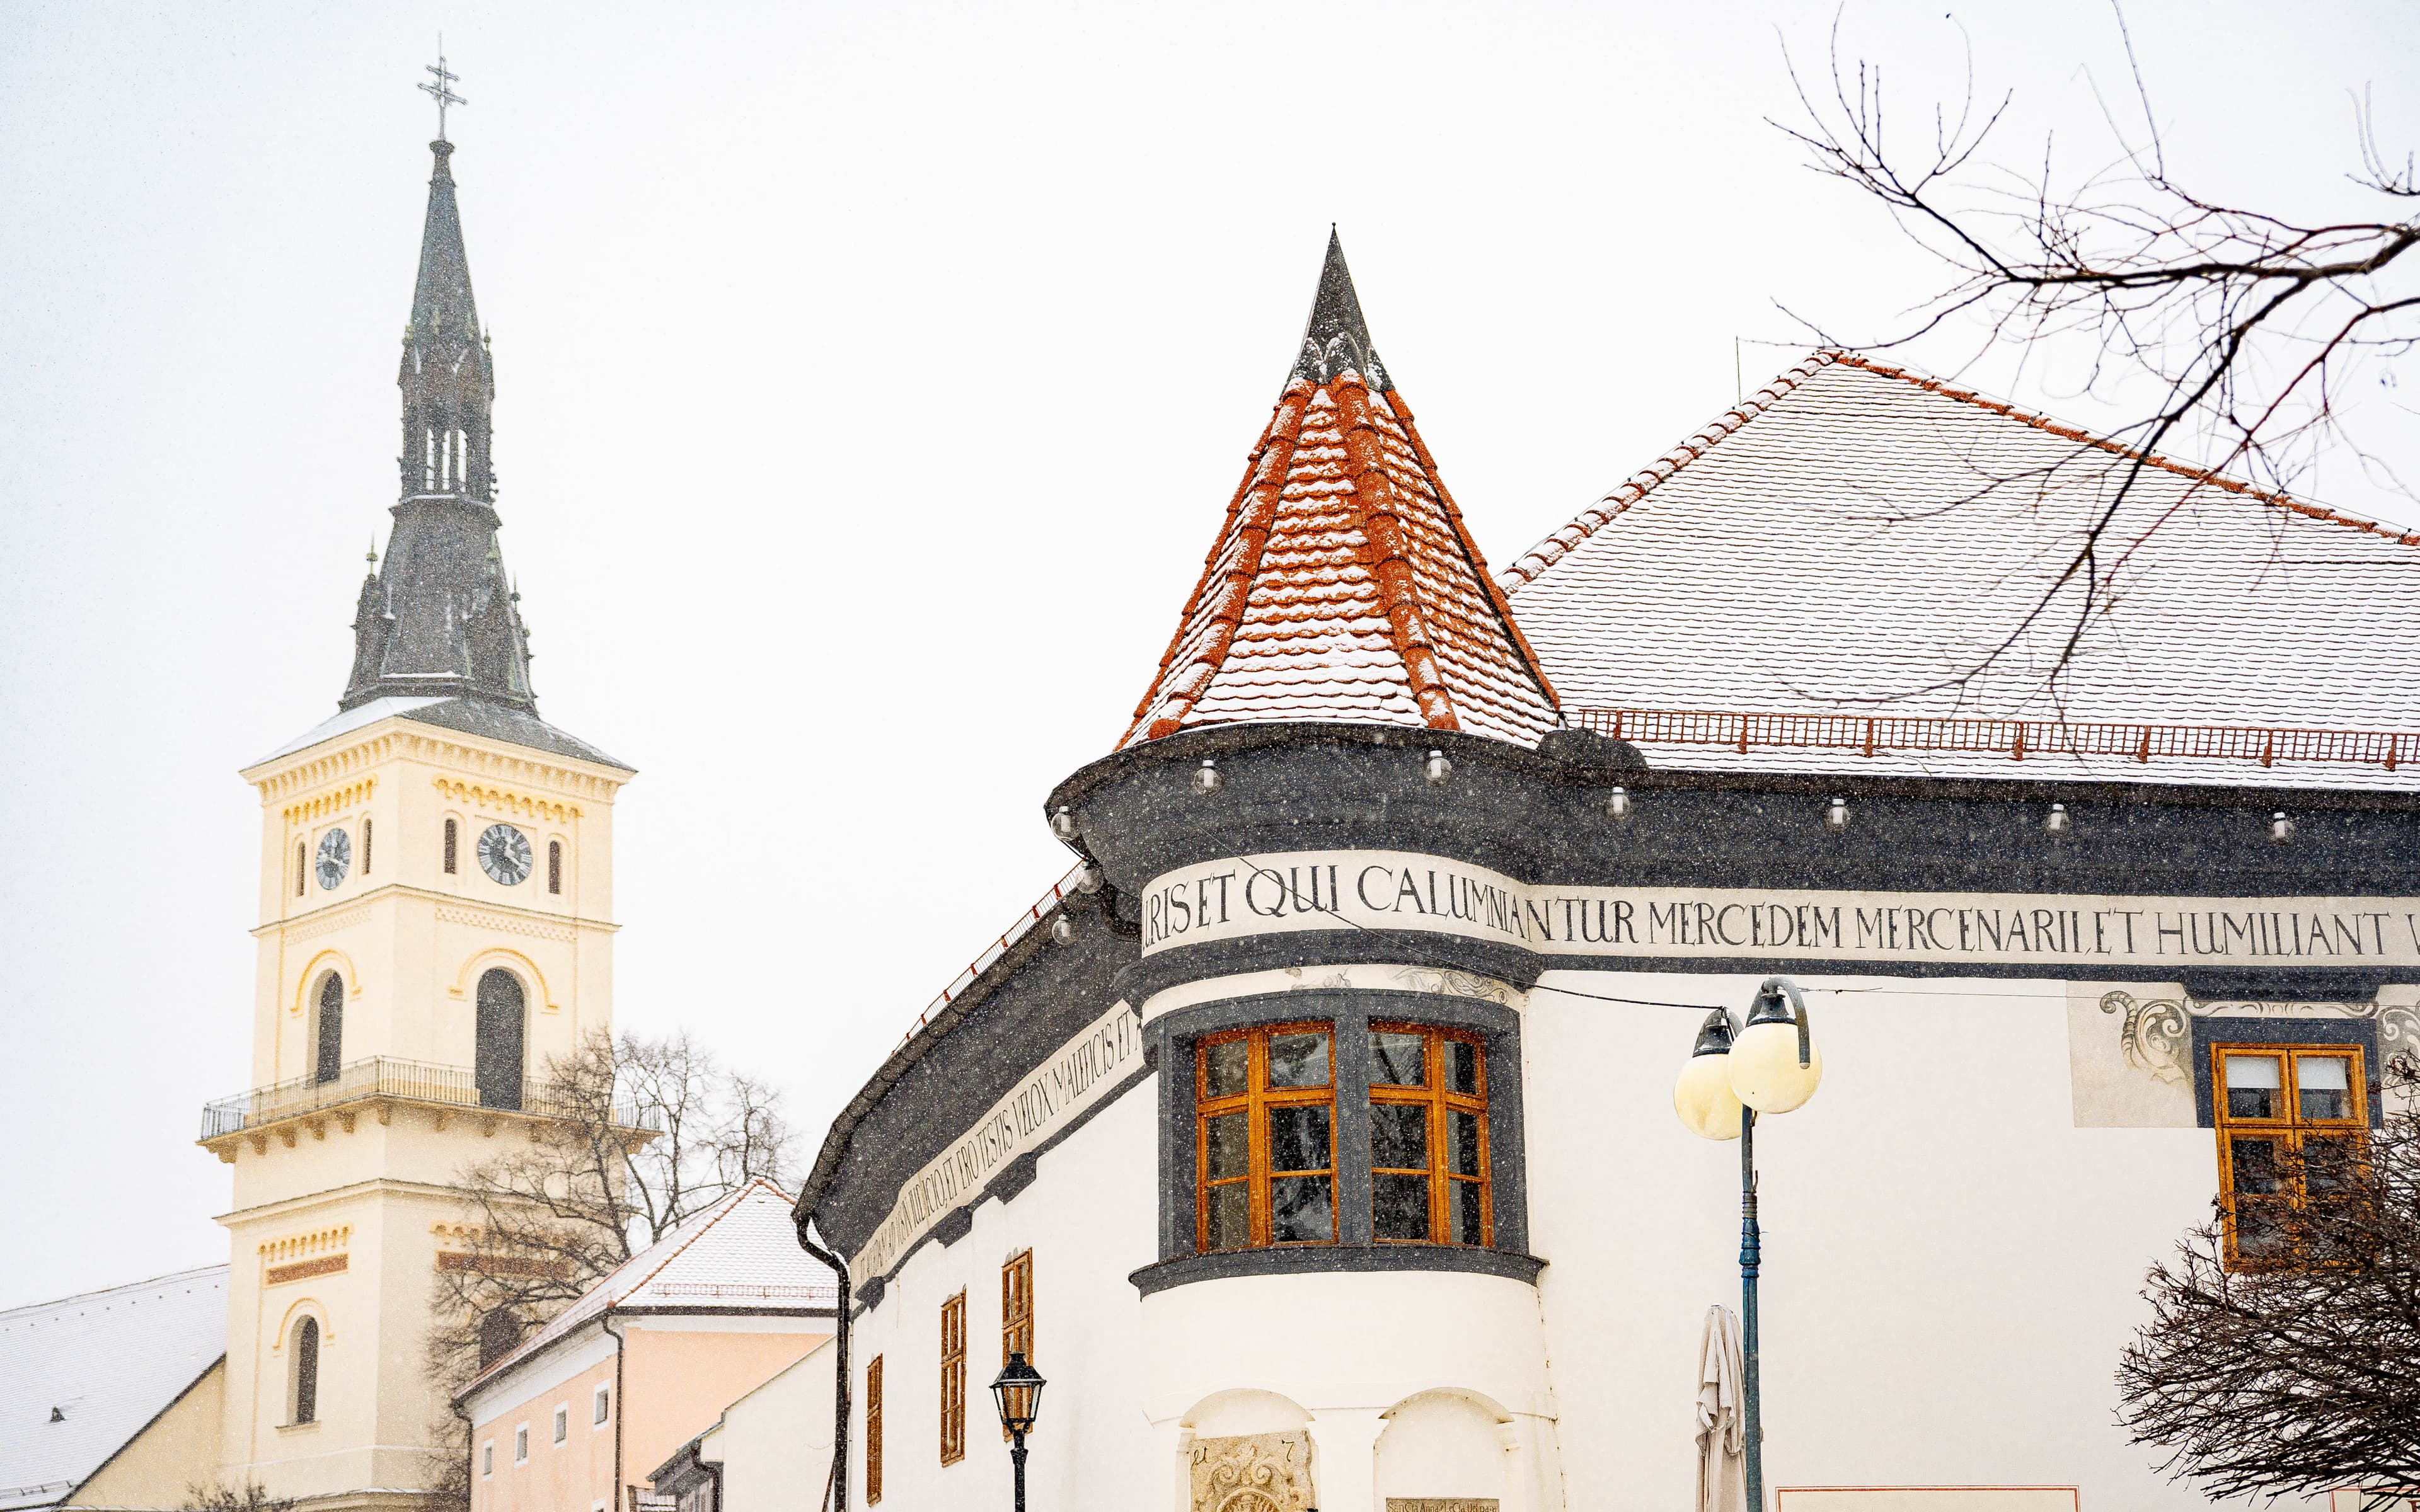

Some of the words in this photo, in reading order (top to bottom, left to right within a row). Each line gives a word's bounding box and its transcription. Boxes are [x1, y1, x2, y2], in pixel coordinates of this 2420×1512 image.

[1196, 869, 1236, 930] ET
[1245, 865, 1340, 918] QUI
[1357, 865, 1639, 944] CALUMNIANTUR
[1649, 900, 1844, 949] MERCEDEM
[2093, 907, 2145, 955] ET
[2155, 911, 2391, 958] HUMILIANT
[943, 1157, 957, 1201] ET
[956, 1140, 979, 1189] ERO
[976, 1109, 1013, 1172] TESTIS
[1012, 1073, 1054, 1139] VELOX
[1052, 1020, 1114, 1111] MALEFICIS
[1117, 1009, 1131, 1063] ET
